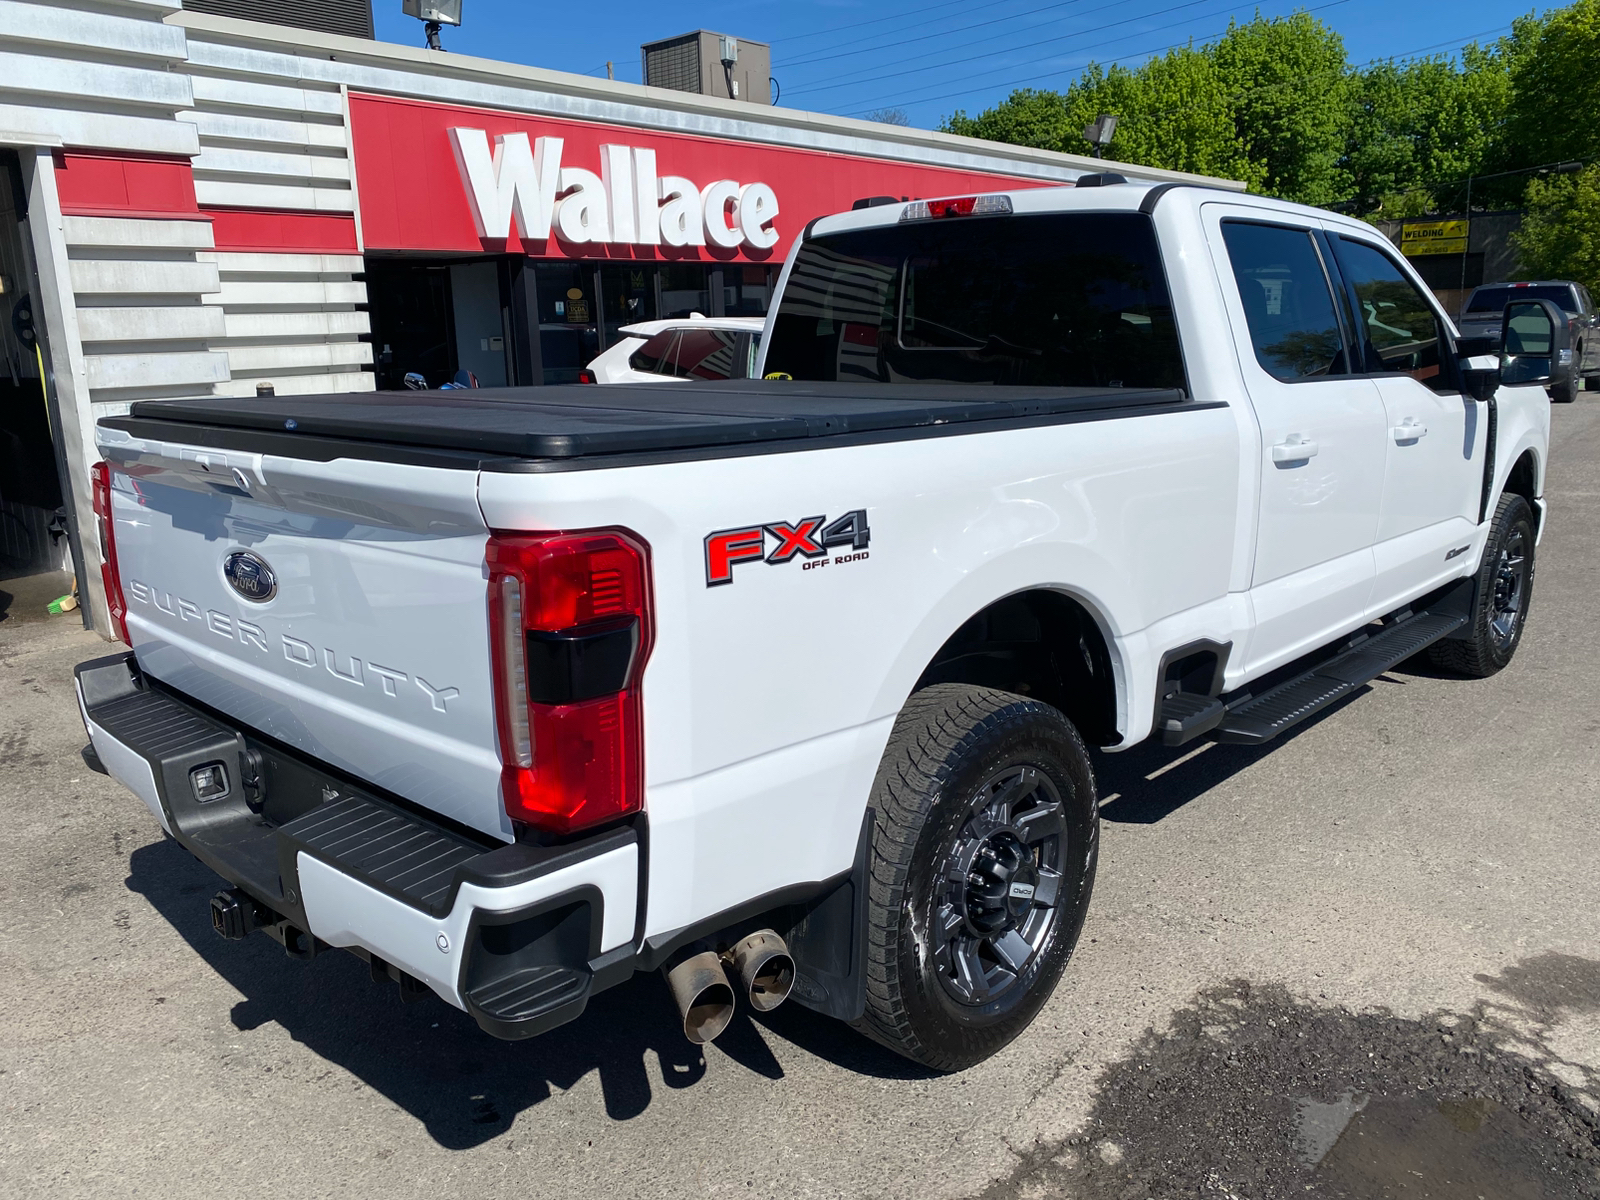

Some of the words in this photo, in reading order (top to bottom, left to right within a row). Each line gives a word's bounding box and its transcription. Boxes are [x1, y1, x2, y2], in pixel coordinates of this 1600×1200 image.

[447, 126, 780, 249] Wallace
[1404, 228, 1444, 238] WELDING
[703, 508, 870, 589] FX4
[802, 559, 830, 571] OFF
[834, 551, 870, 565] ROAD
[231, 562, 260, 593] Ford
[130, 579, 269, 653] SUPER
[282, 634, 461, 713] DUTY
[1013, 887, 1032, 895] FORD
